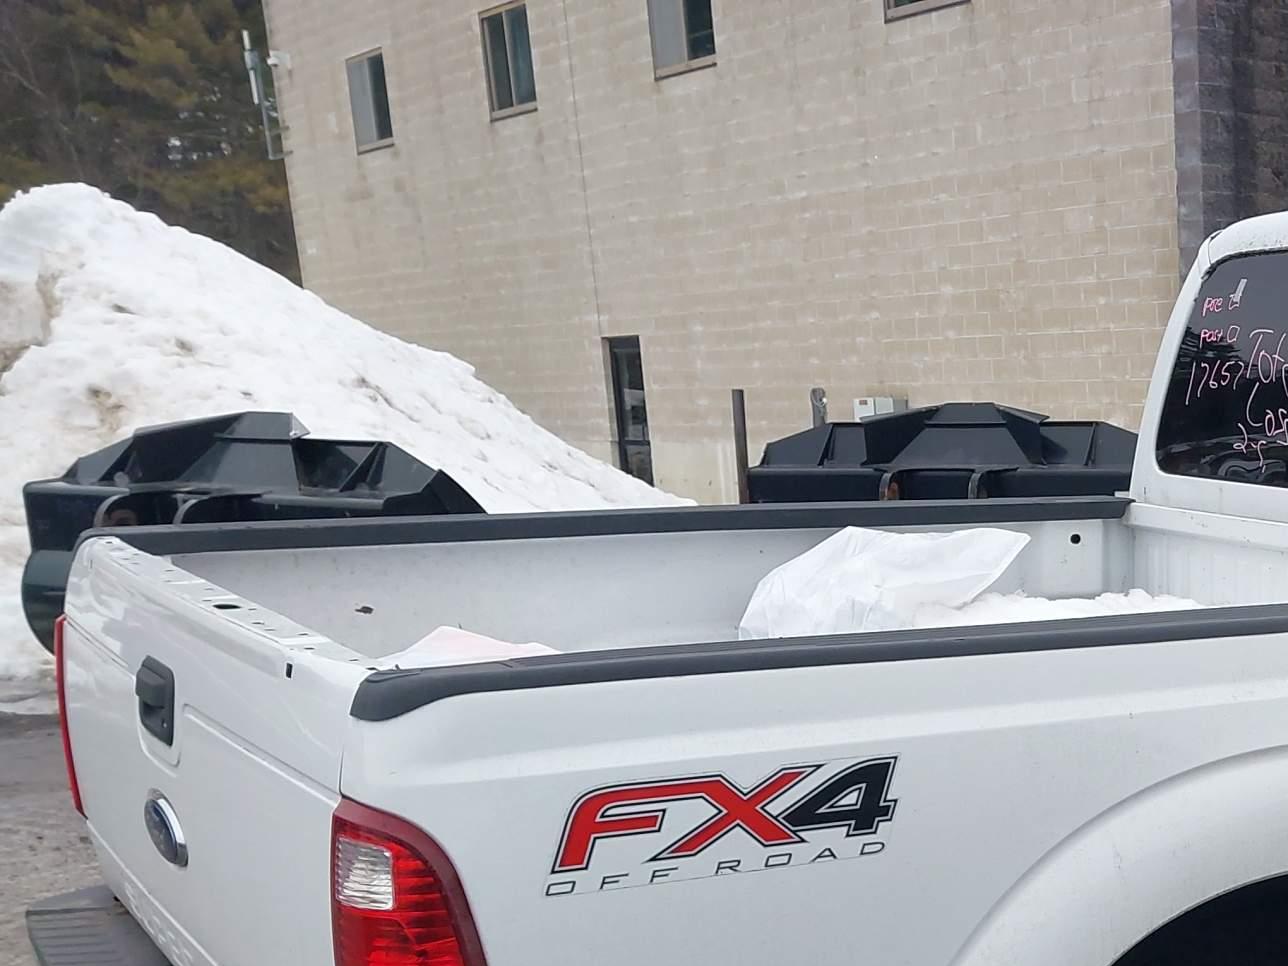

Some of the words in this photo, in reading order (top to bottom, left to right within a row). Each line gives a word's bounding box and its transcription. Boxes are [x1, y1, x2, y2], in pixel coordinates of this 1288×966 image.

[549, 755, 899, 874] FX4
[545, 866, 680, 896] OFF
[714, 841, 886, 875] ROAD
